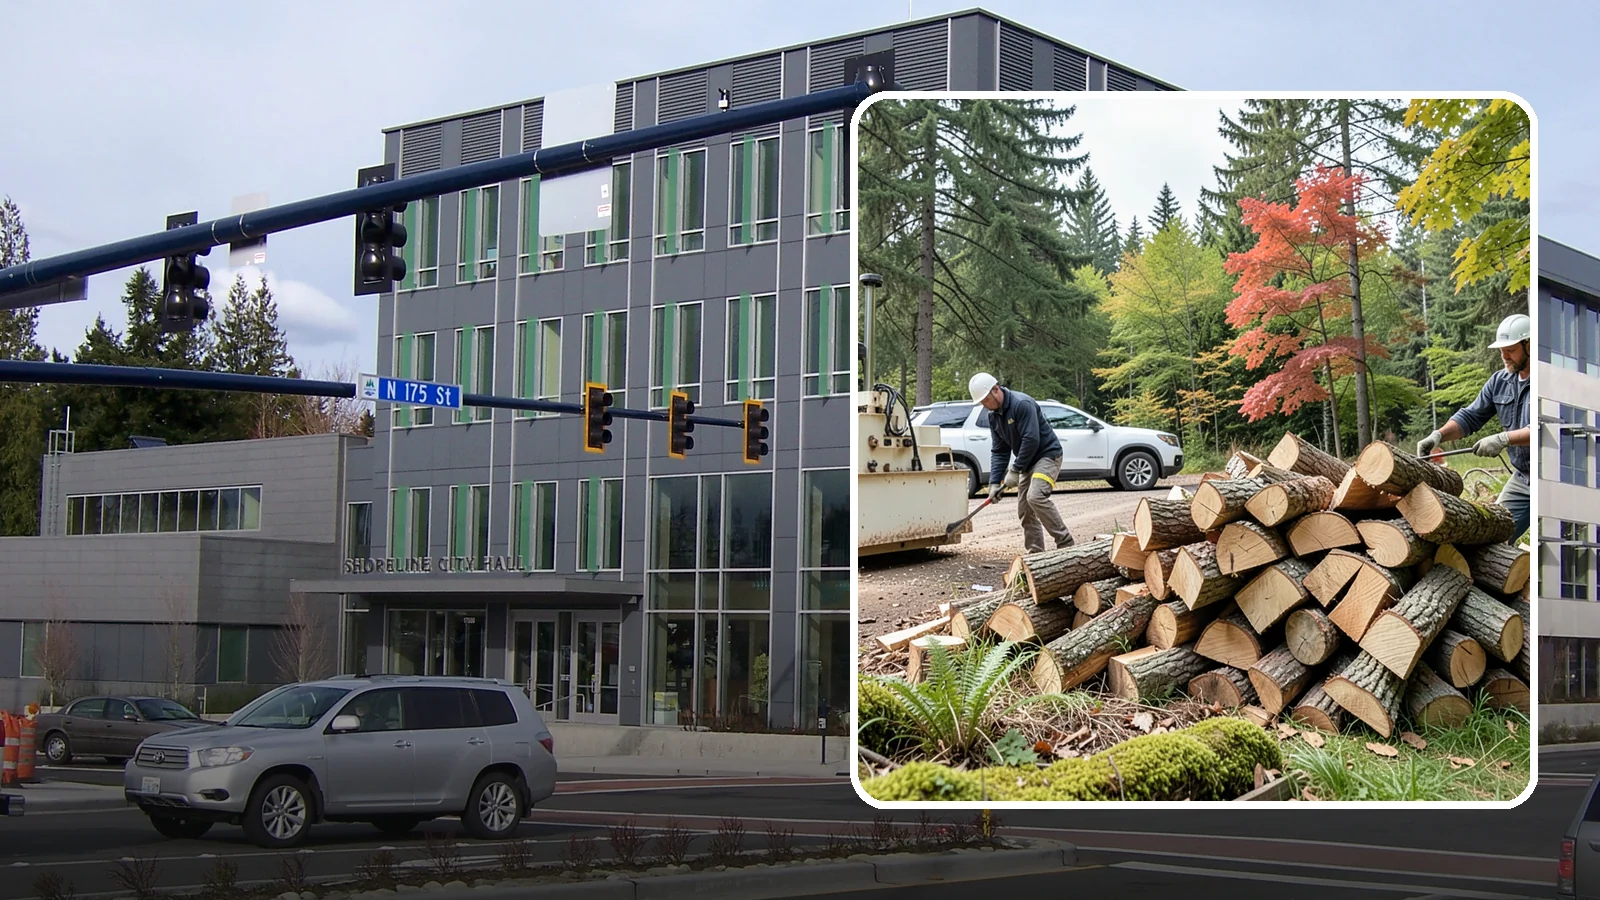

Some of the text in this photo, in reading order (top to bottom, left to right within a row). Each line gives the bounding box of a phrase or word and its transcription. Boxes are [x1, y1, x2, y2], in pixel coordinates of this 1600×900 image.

[387, 380, 452, 406] N 175 St
[343, 555, 526, 573] SHORELINE CITY HALL
